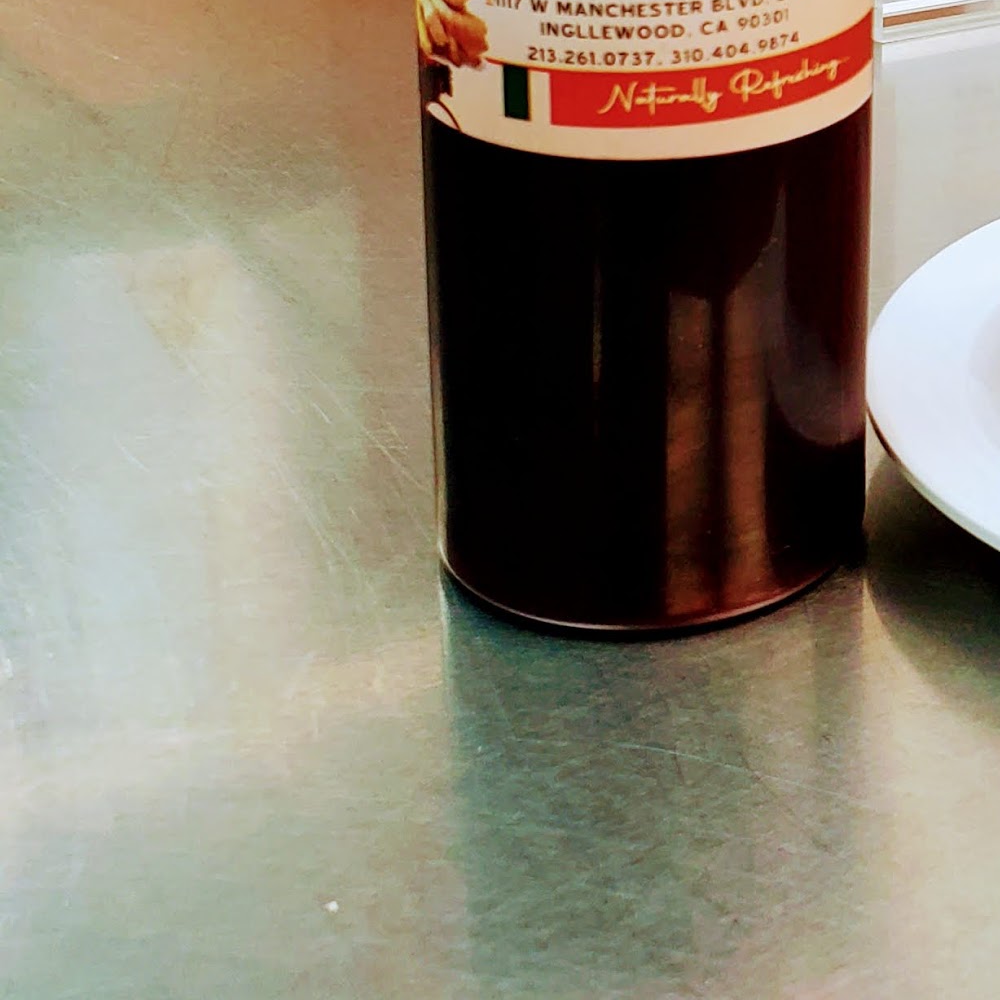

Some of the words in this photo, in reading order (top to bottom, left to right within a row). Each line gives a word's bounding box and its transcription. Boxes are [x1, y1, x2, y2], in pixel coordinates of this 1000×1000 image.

[557, 0, 703, 18] MANCHESTER
[701, 20, 728, 36] CA
[737, 8, 789, 31] 90301
[672, 30, 800, 62] 310.404.9874
[597, 77, 724, 115] Naturally
[729, 55, 851, 101] Refreshing
